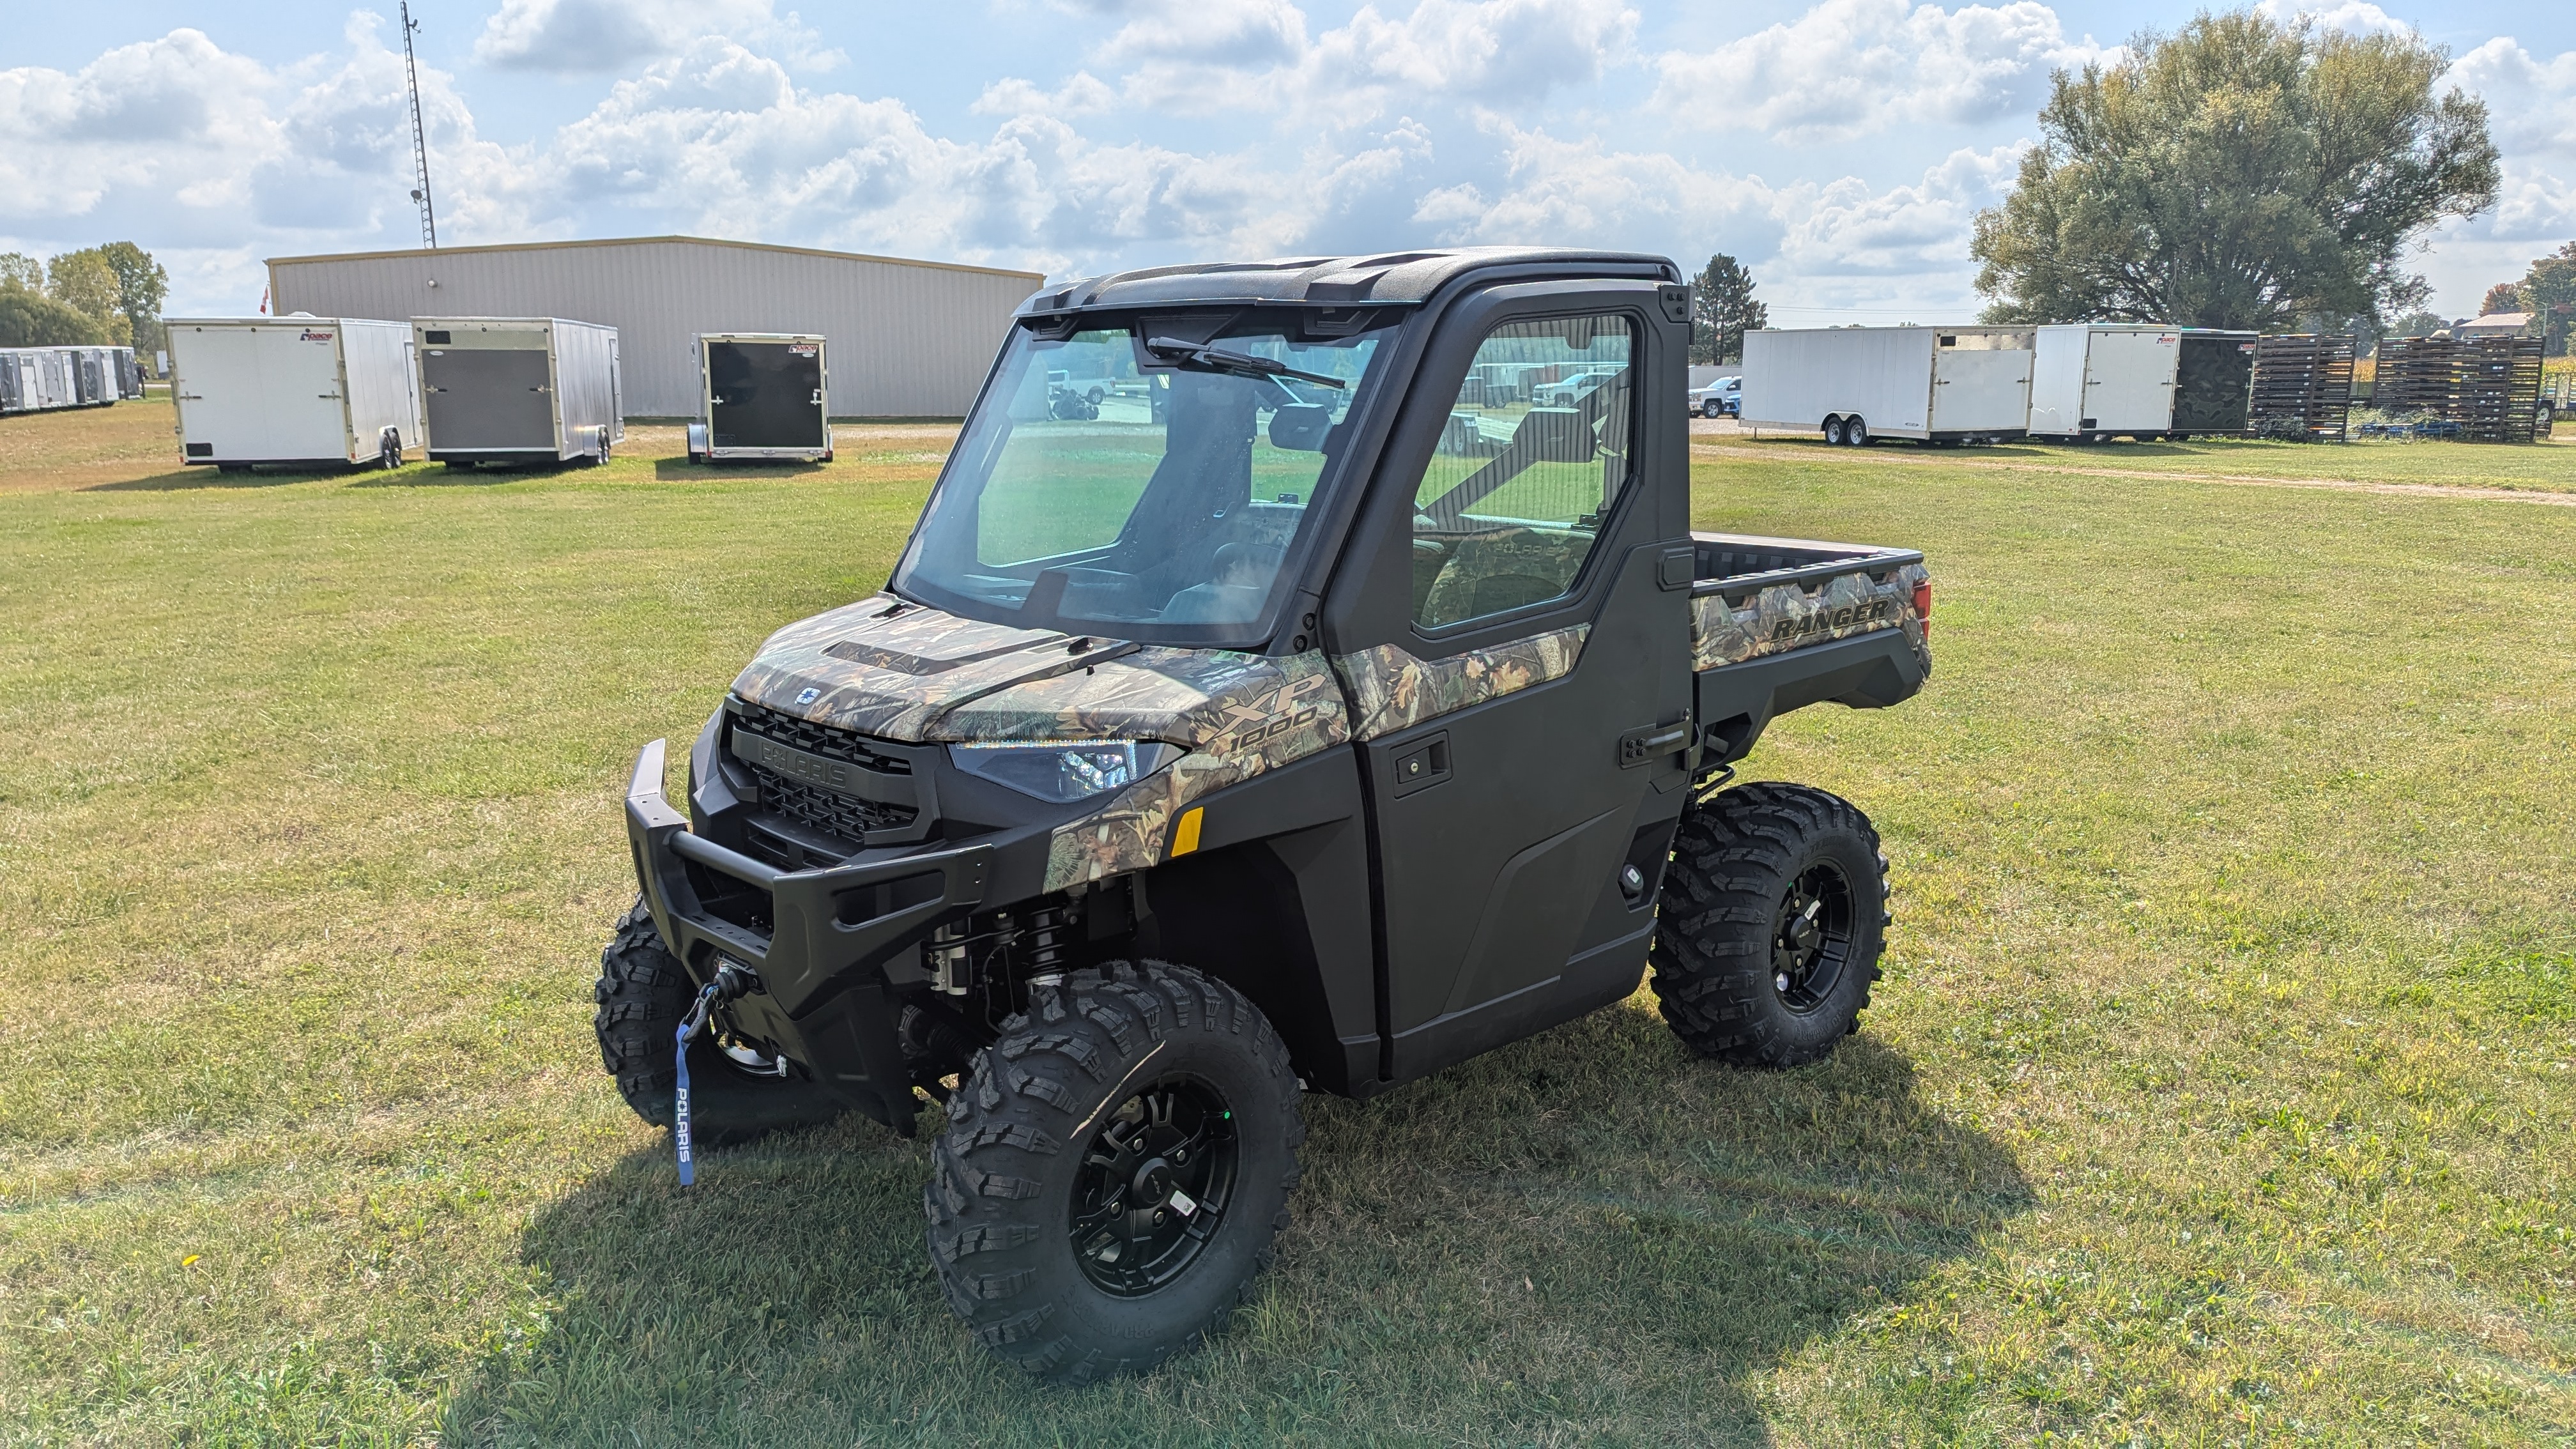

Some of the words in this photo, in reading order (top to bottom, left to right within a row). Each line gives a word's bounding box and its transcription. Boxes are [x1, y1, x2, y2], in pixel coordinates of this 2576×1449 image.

[1770, 599, 1889, 643] RANGER
[1202, 673, 1327, 744] XP
[1229, 705, 1317, 753] 1000
[762, 742, 847, 788] POLARIS
[677, 1087, 690, 1163] POLARIS
